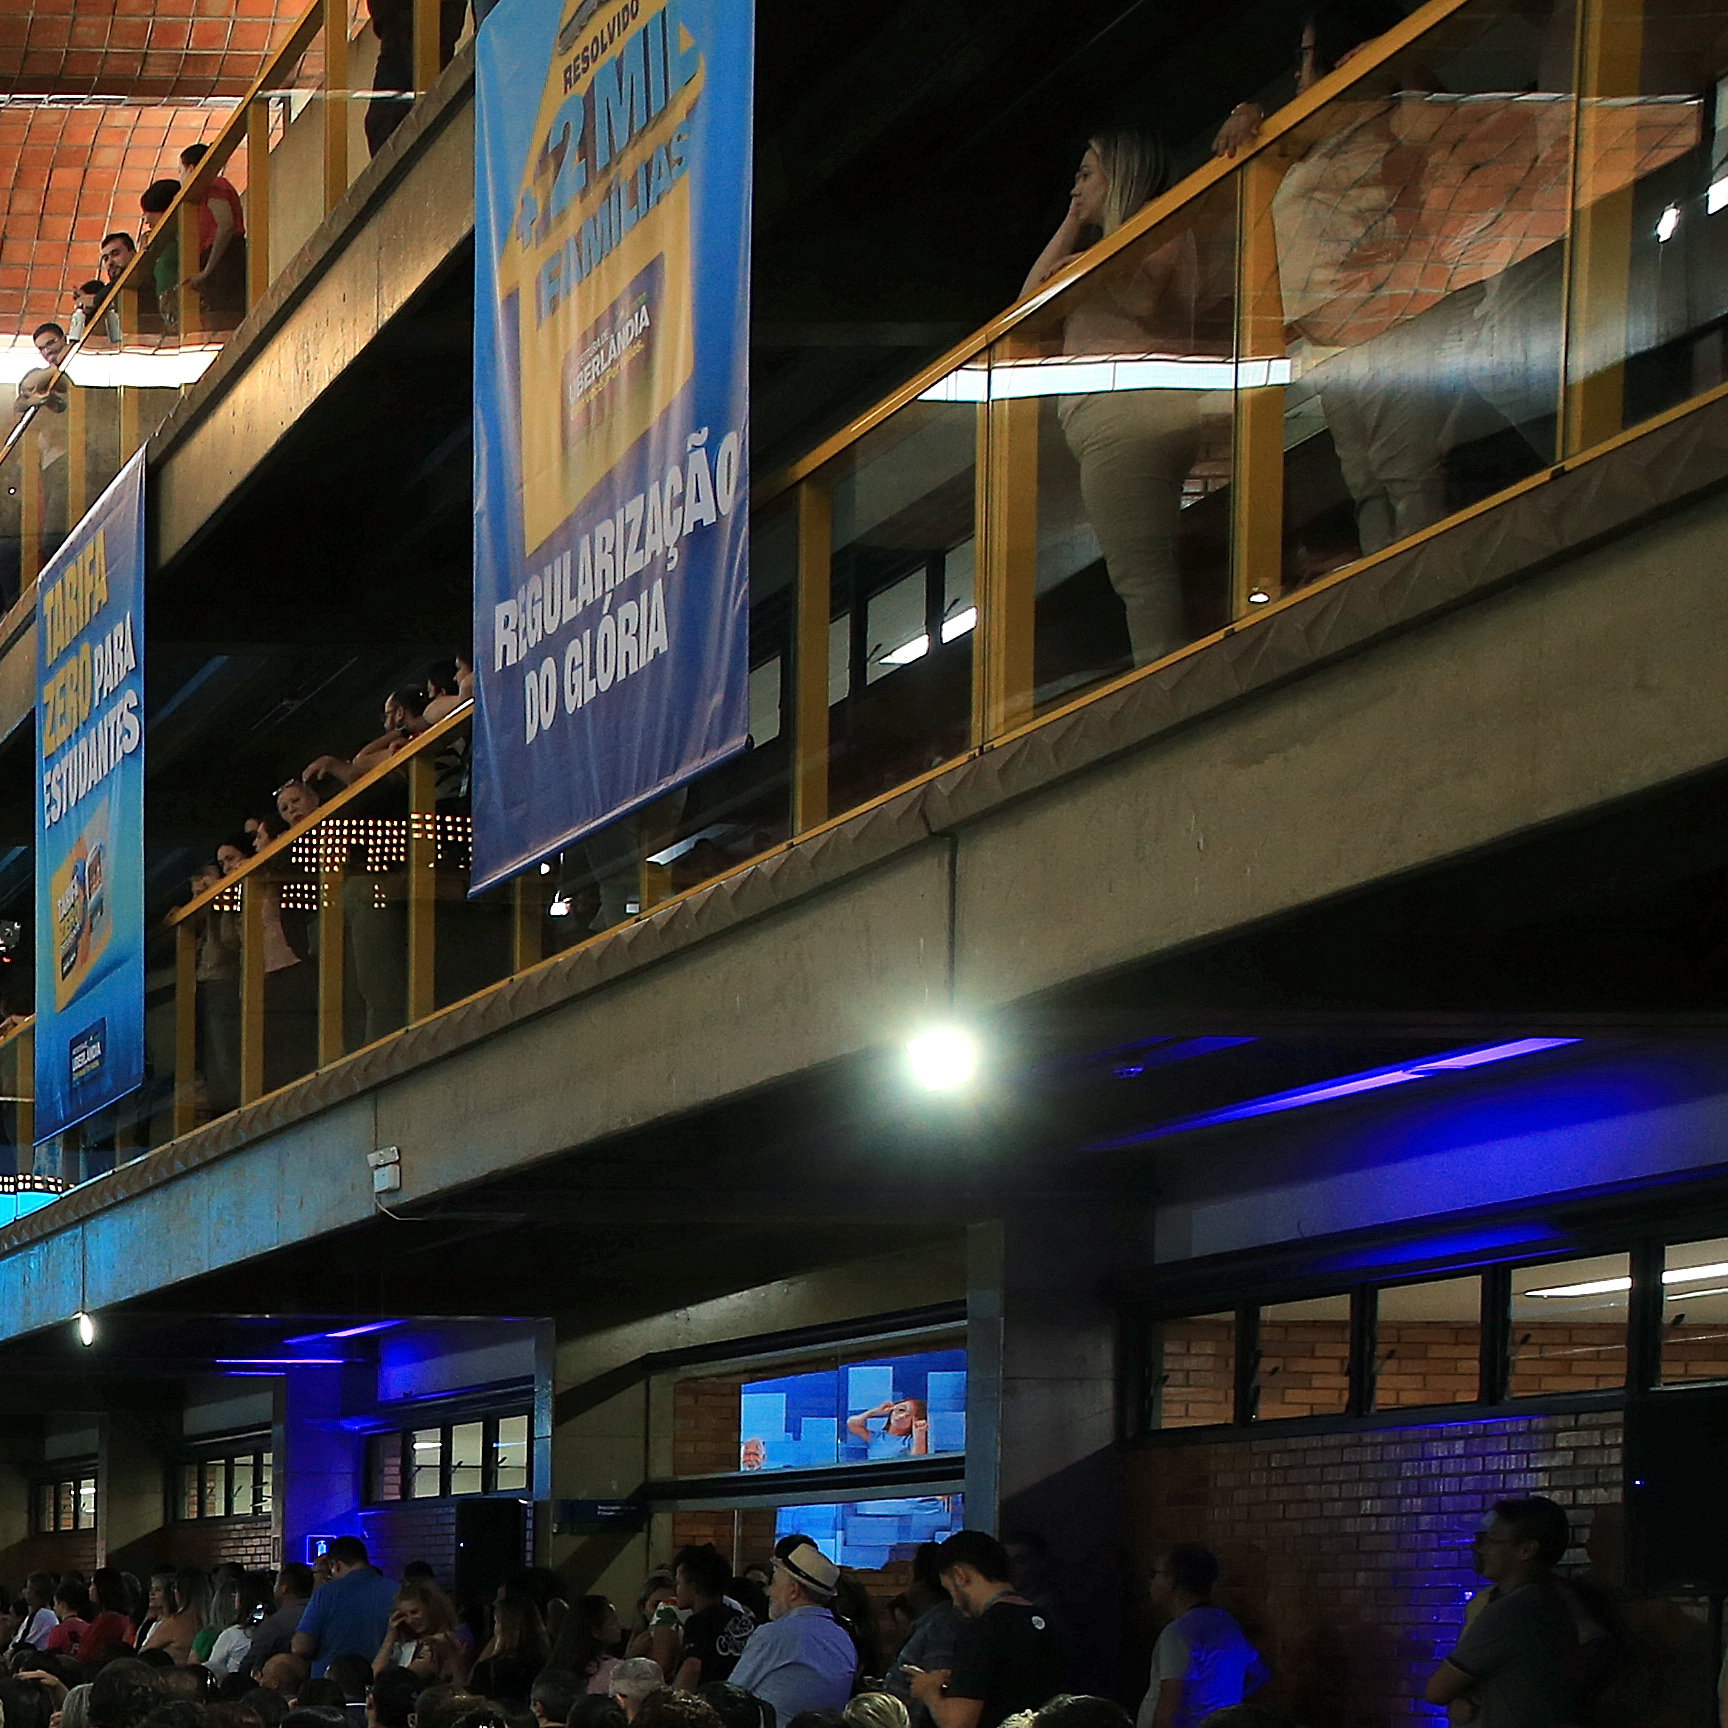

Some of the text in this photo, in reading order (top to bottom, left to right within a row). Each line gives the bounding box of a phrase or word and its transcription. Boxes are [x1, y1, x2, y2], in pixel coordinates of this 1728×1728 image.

[563, 0, 639, 95] RESOLVIDO
[594, 2, 701, 173] MIL
[539, 120, 691, 327] FAMÍLIAS
[44, 529, 109, 668] TARIFA
[495, 427, 740, 673] REGULARIZAÇÃO
[44, 611, 137, 759] ZERO PARA
[525, 578, 669, 744] DO GLÓRIA
[45, 688, 140, 830] ESTUDANTES
